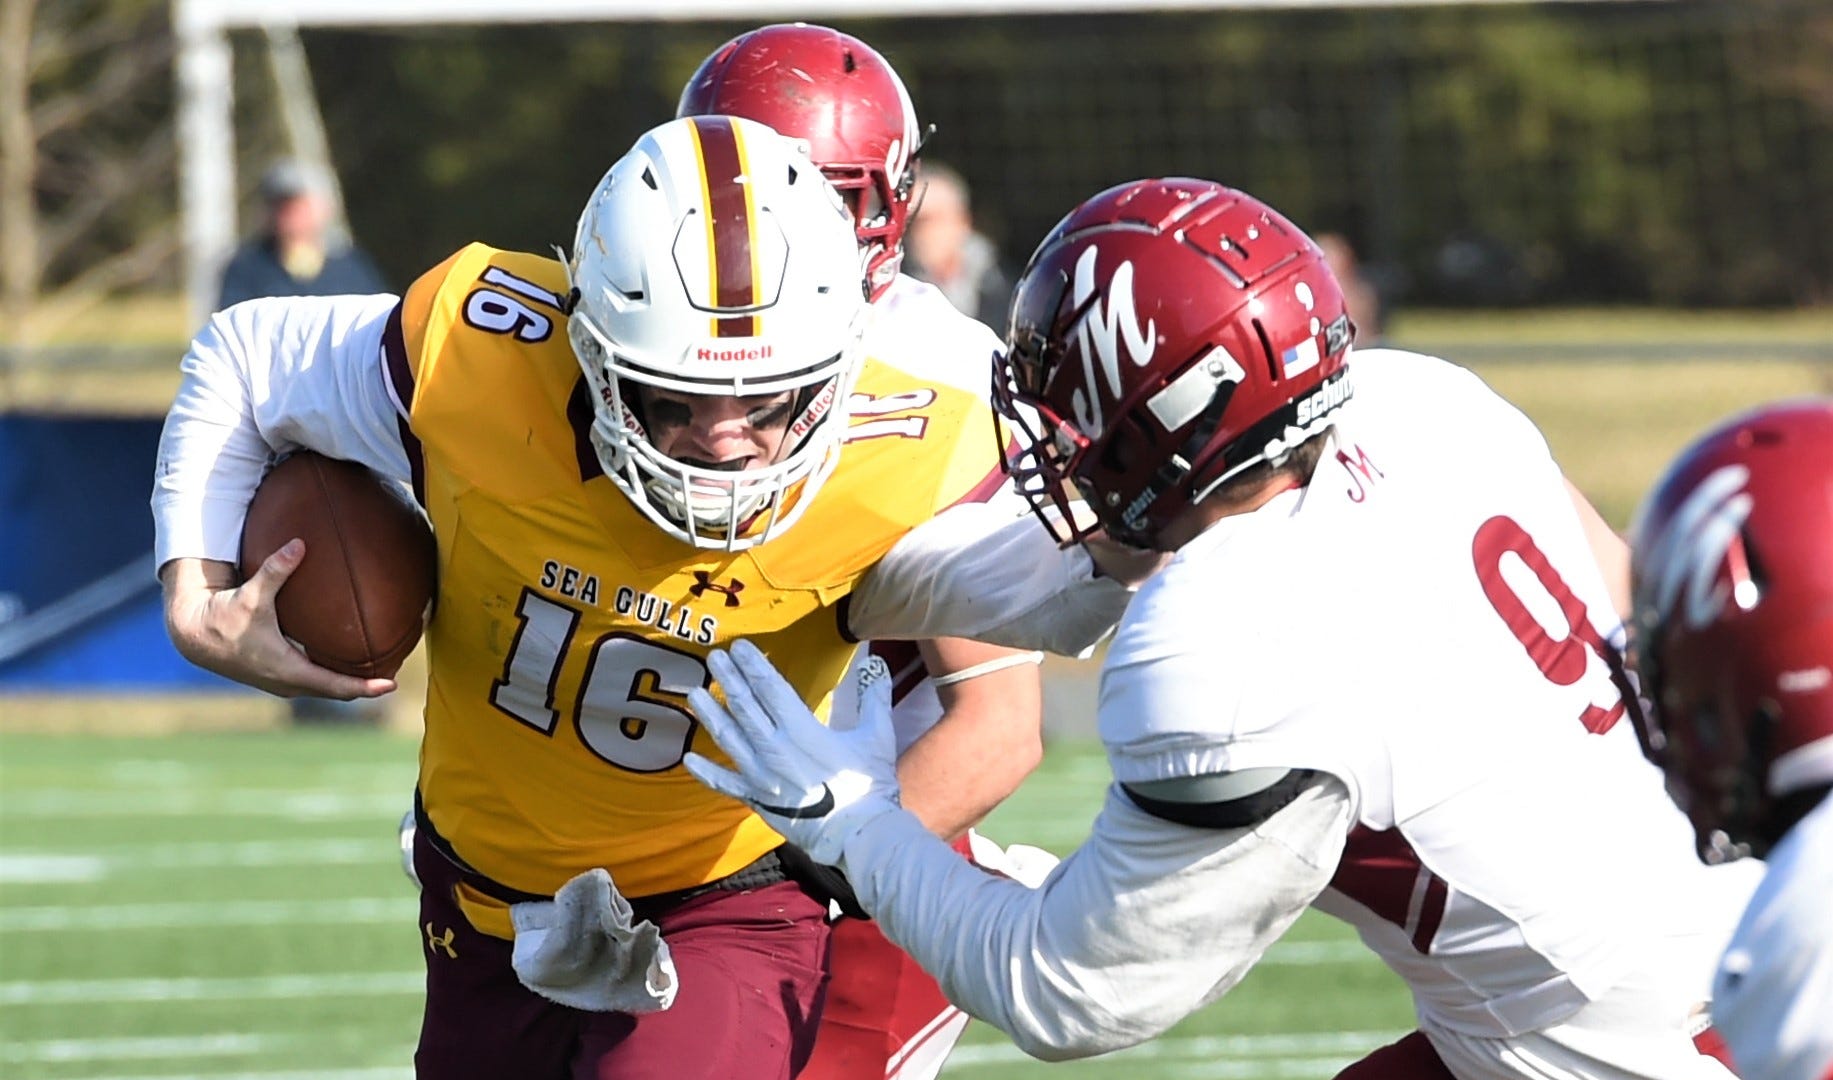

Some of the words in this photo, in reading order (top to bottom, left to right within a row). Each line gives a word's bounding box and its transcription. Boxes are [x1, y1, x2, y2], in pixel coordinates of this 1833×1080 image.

[462, 265, 572, 344] 16
[696, 344, 773, 361] Riddell
[843, 388, 938, 445] 16
[540, 560, 599, 604] SEA
[615, 586, 717, 645] GULLS
[1472, 515, 1626, 736] 9
[489, 584, 712, 774] 16
